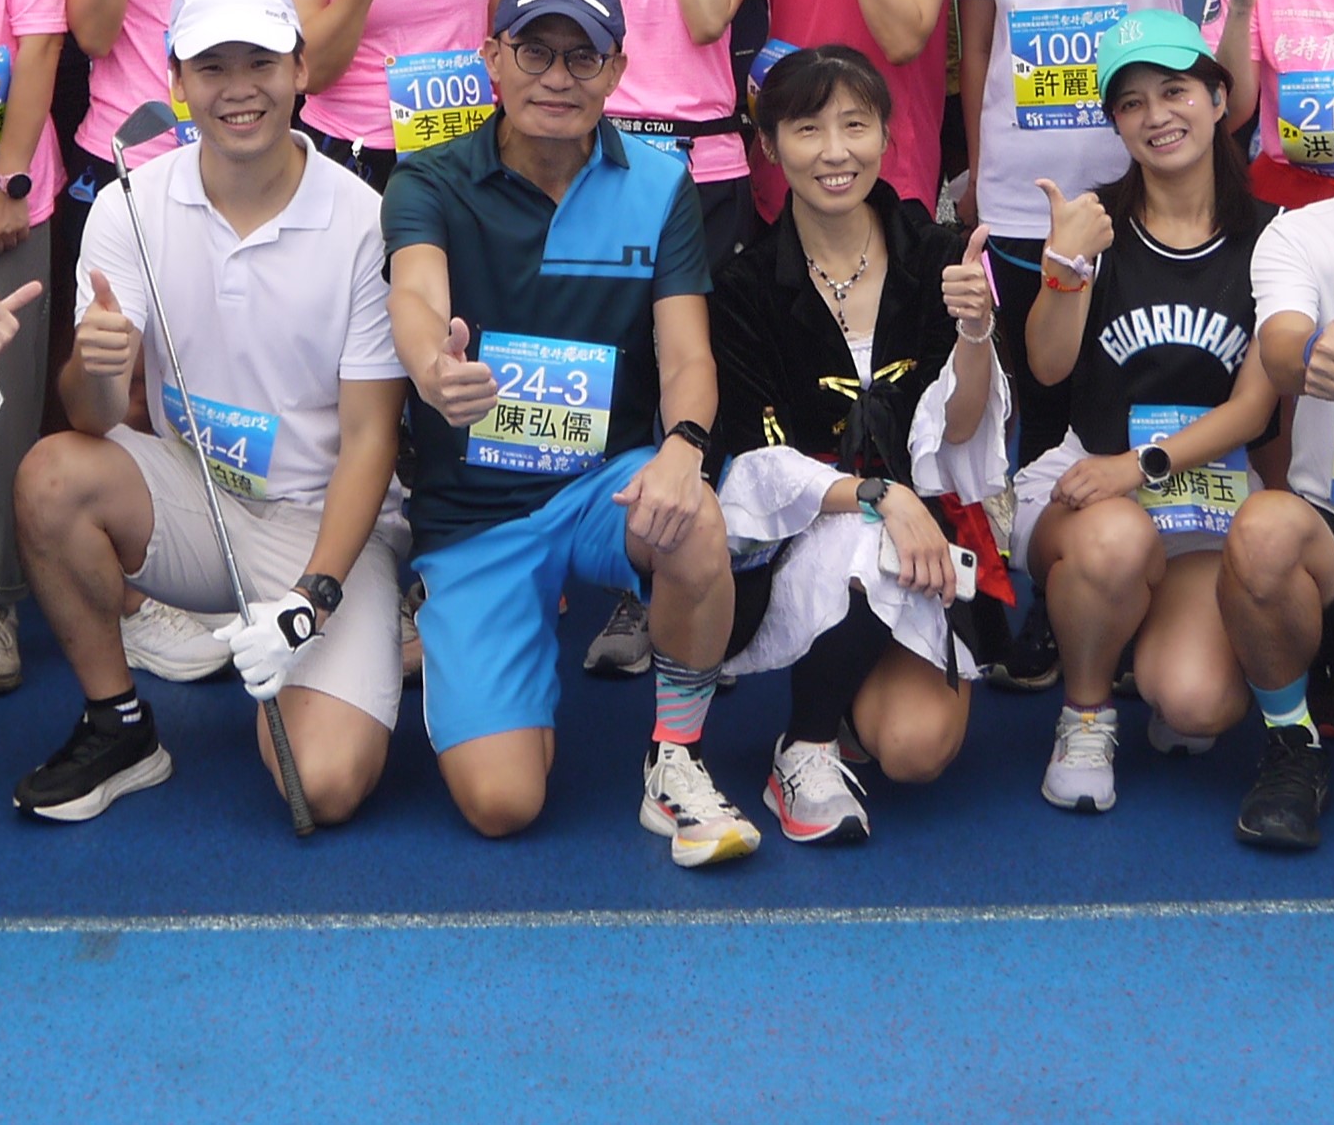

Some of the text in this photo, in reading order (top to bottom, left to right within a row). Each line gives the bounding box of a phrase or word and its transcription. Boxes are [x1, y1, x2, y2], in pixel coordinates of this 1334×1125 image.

[406, 74, 482, 111] 1009
[1033, 68, 1099, 98] 許麗
[644, 121, 674, 134] CTAU
[496, 362, 589, 407] 24-3
[494, 403, 593, 444] 陳弘儒
